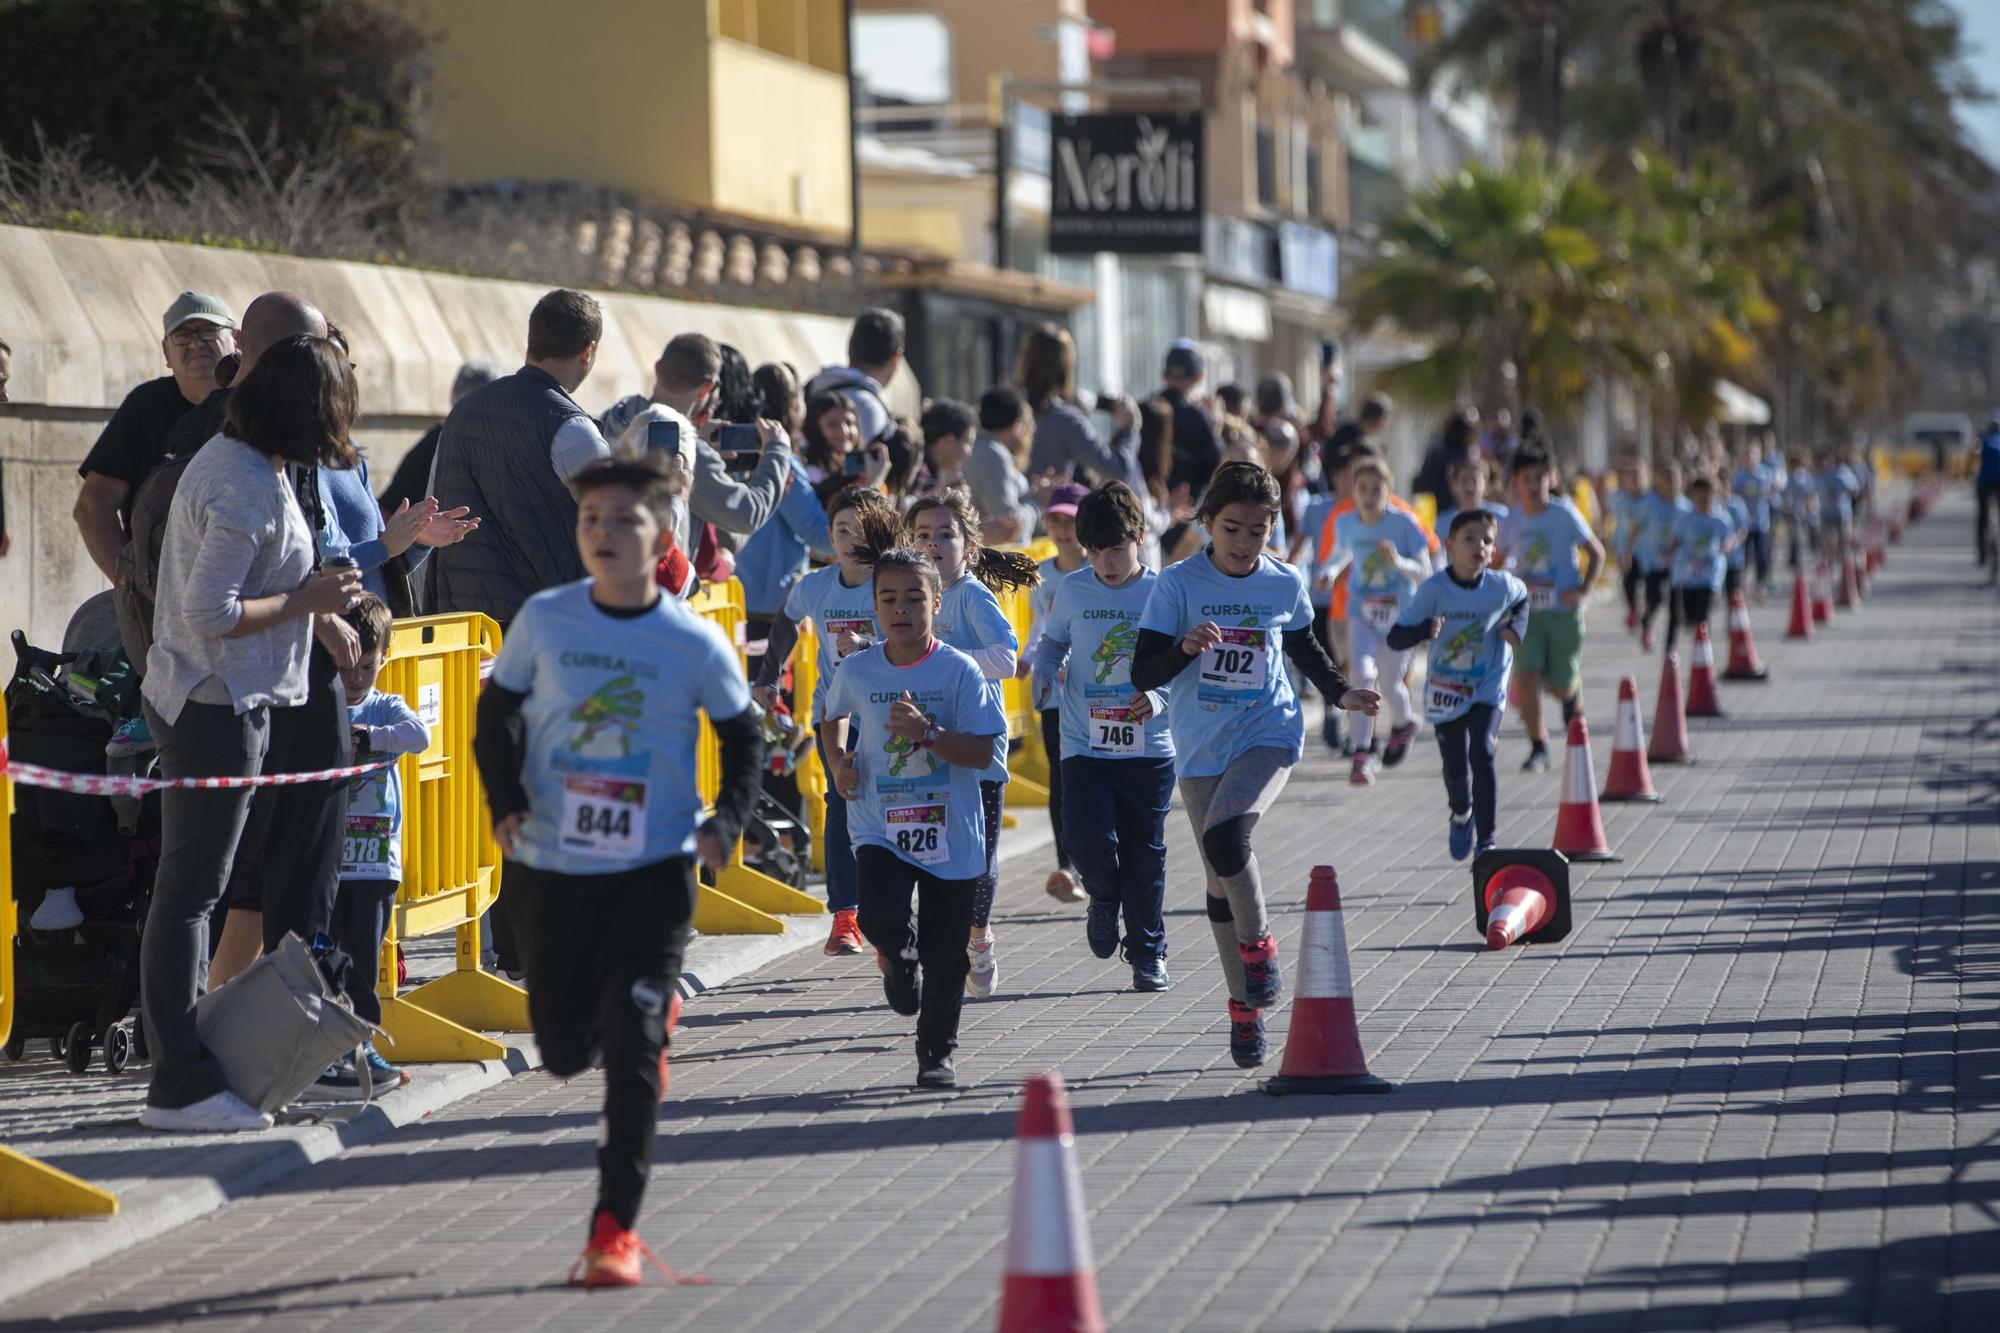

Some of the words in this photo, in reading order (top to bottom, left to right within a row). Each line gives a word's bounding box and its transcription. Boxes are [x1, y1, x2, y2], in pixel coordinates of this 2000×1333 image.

[1056, 136, 1195, 211] Neroli
[824, 609, 860, 619] CURSA
[1083, 609, 1125, 619] CURSA
[1201, 604, 1252, 616] CURSA
[559, 650, 625, 672] CURSA
[1214, 648, 1254, 674] 702
[1100, 725, 1134, 746] 746
[577, 804, 631, 839] 844
[889, 809, 915, 817] CURSA
[343, 837, 380, 862] 378
[897, 827, 938, 852] 826
